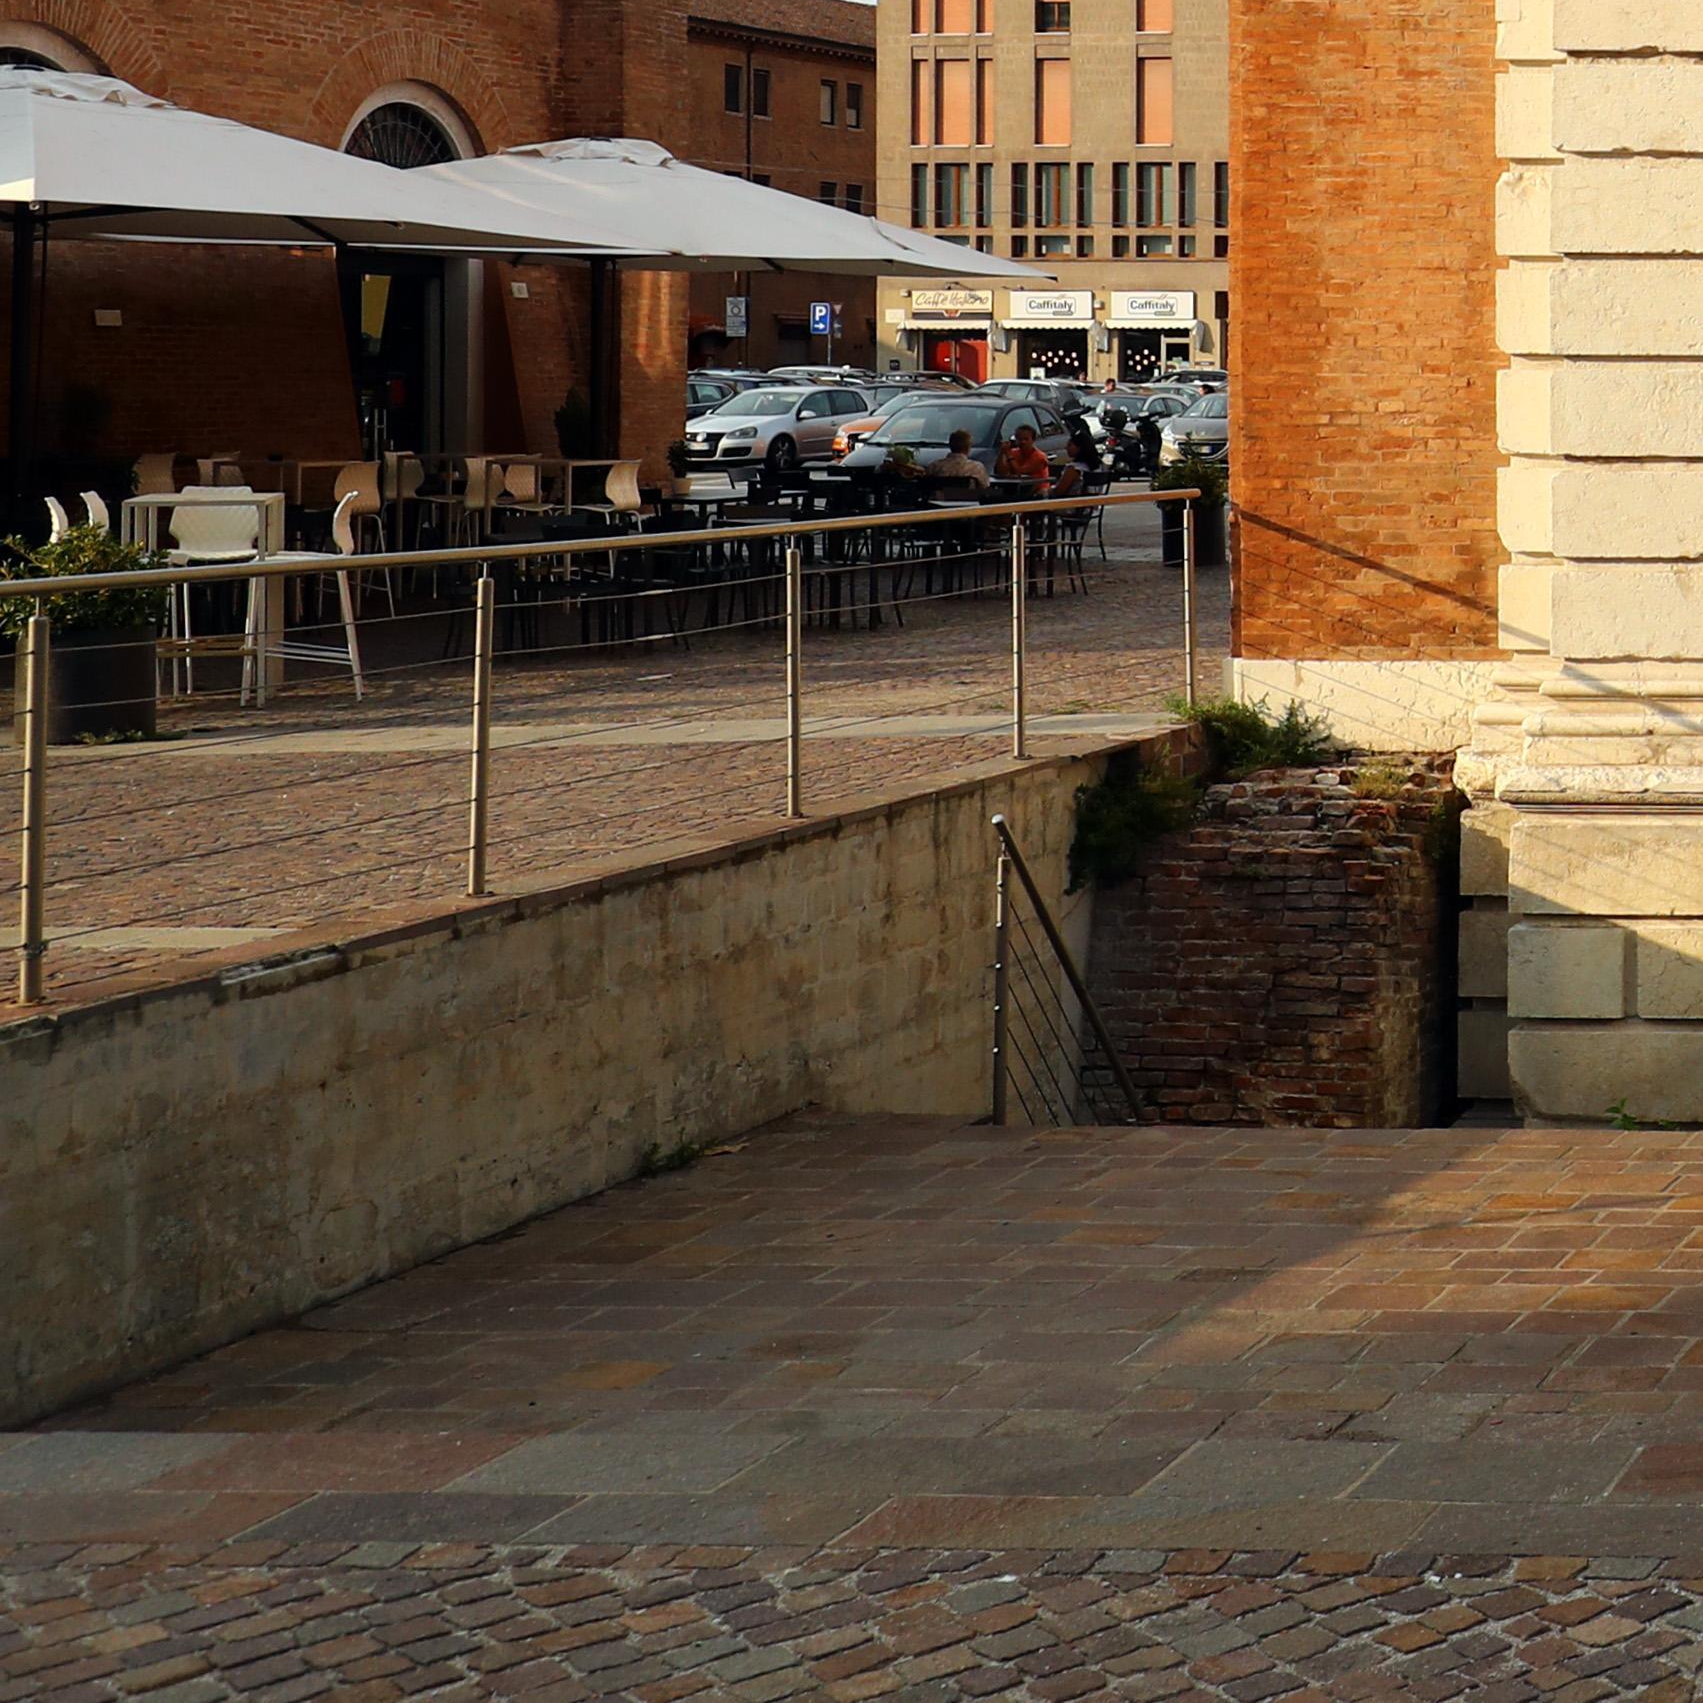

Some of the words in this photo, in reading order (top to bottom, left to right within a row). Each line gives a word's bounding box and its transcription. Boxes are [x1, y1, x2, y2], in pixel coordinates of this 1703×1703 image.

[1029, 300, 1073, 312] Caffitaly
[1130, 300, 1175, 312] Caffitaly
[815, 305, 827, 322] P
